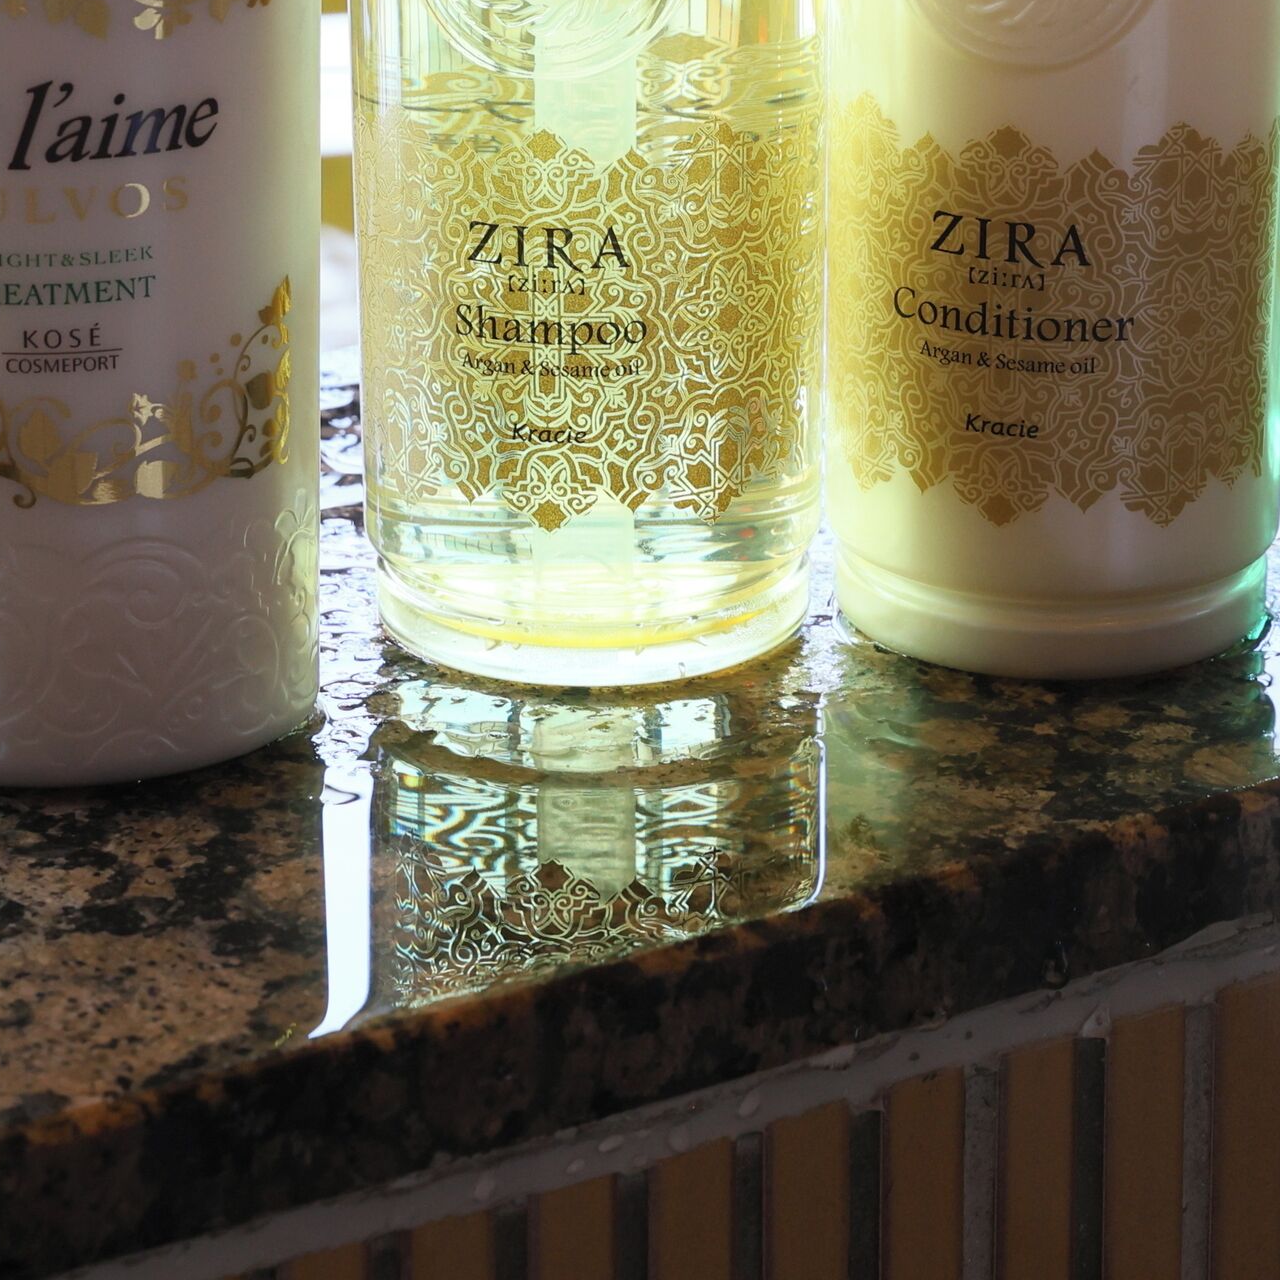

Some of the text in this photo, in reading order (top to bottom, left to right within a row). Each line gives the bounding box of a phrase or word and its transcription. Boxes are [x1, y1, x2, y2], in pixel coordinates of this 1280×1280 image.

[7, 79, 219, 171] l'aime
[467, 220, 631, 273] ZIRA
[929, 210, 1092, 269] ZIRA
[456, 303, 647, 355] Shampoo
[893, 286, 1134, 343] Conditioner
[22, 322, 102, 349] KOSÉ
[4, 354, 120, 374] COSMEPORT
[462, 352, 641, 378] Argan & Sesame oil
[920, 340, 1097, 374] Argan & Sesame oil
[511, 423, 588, 444] Kracie
[964, 413, 1040, 439] Kracie
